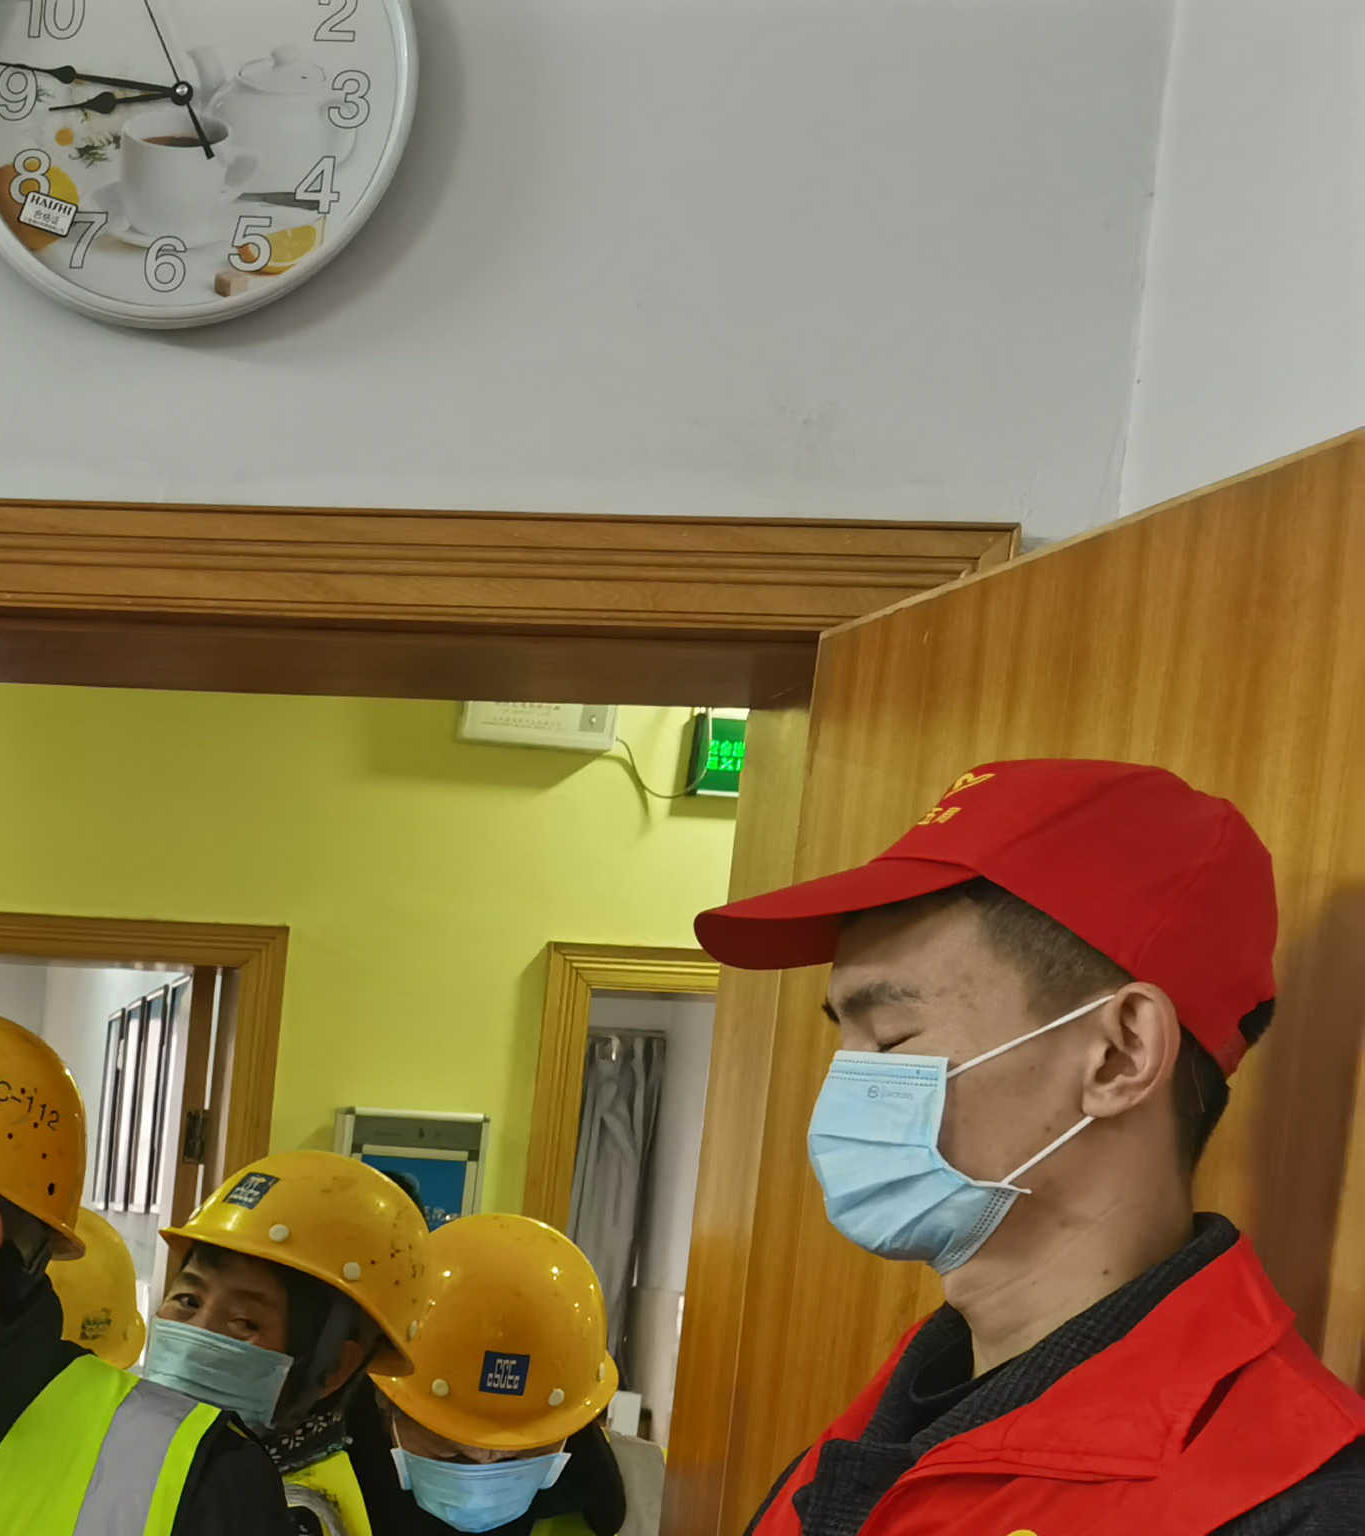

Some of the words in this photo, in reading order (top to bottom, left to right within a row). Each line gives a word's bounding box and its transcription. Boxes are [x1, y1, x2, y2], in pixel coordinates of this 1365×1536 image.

[27, 0, 86, 40] 10
[313, 0, 359, 43] 2
[327, 69, 371, 130] 3
[8, 148, 52, 206] 8
[295, 155, 341, 215] 4
[68, 211, 109, 270] 7
[143, 235, 188, 293] 6
[227, 215, 273, 273] 5
